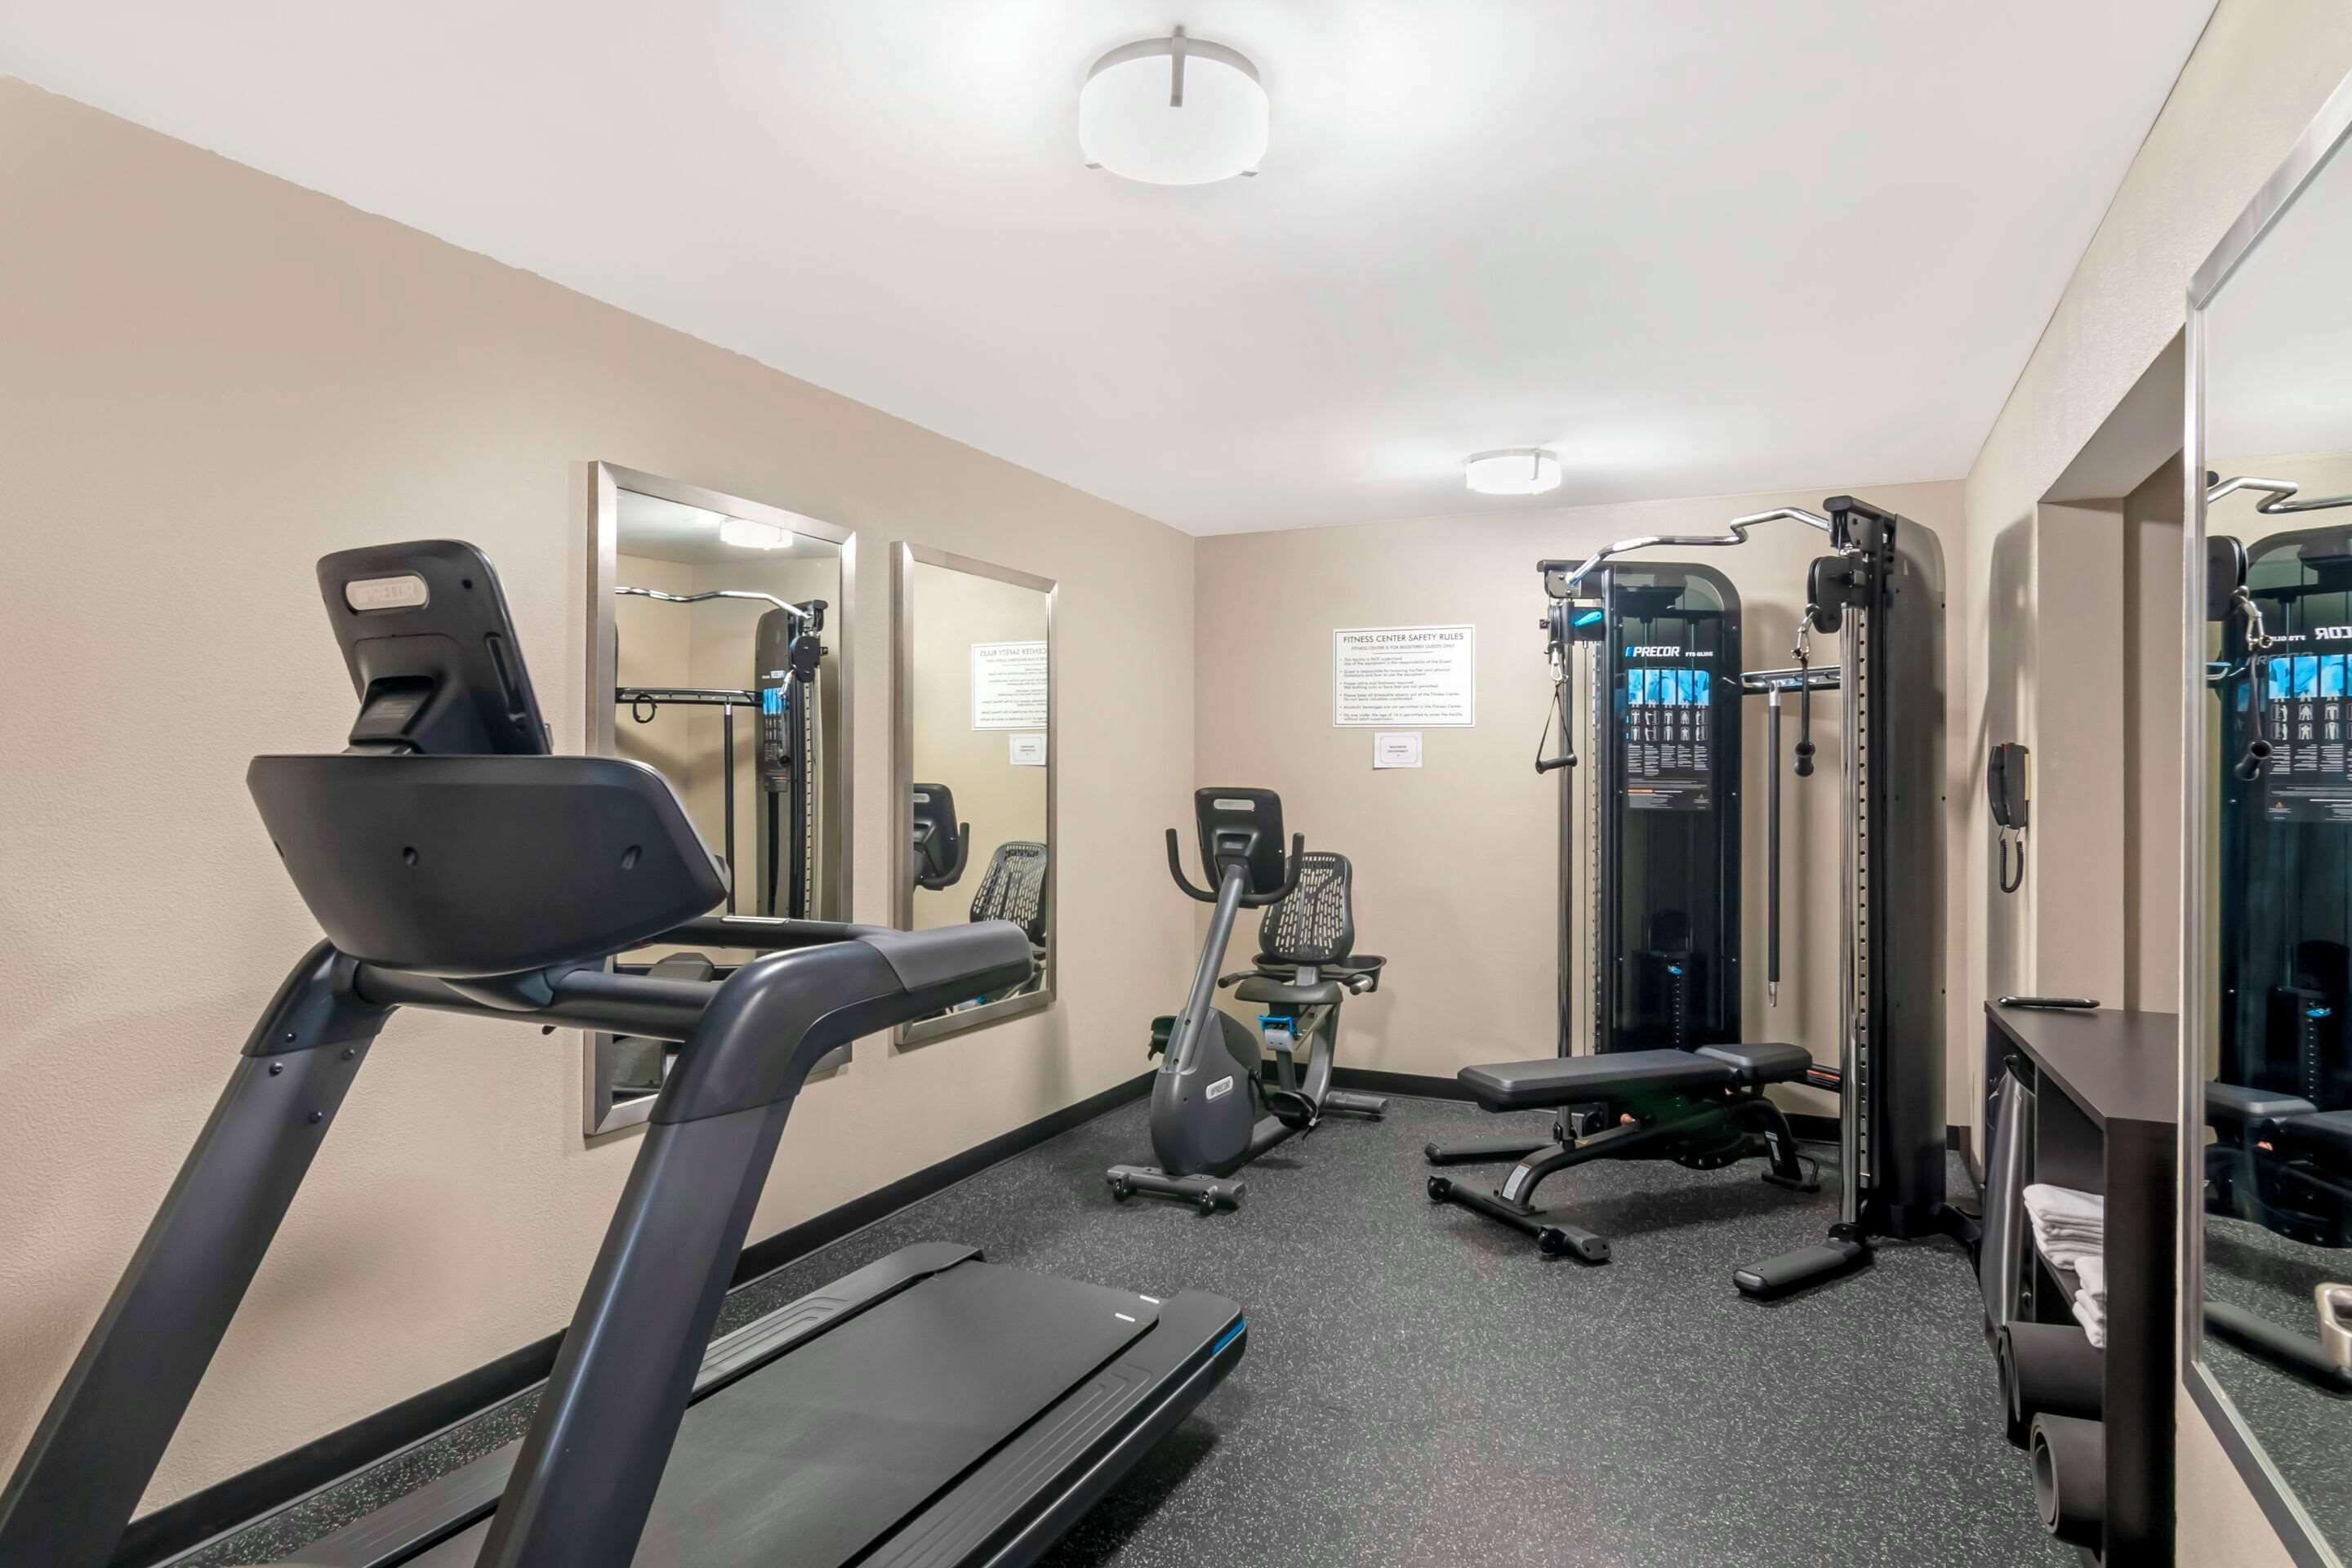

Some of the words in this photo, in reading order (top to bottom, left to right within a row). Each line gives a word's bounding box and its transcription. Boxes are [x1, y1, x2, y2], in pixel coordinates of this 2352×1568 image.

[1343, 635, 1374, 644] FITNESS
[1375, 635, 1406, 643] CENTER
[1408, 634, 1437, 642] SAFETY
[1439, 633, 1464, 641] RULES
[1633, 646, 1681, 657] PRECOR
